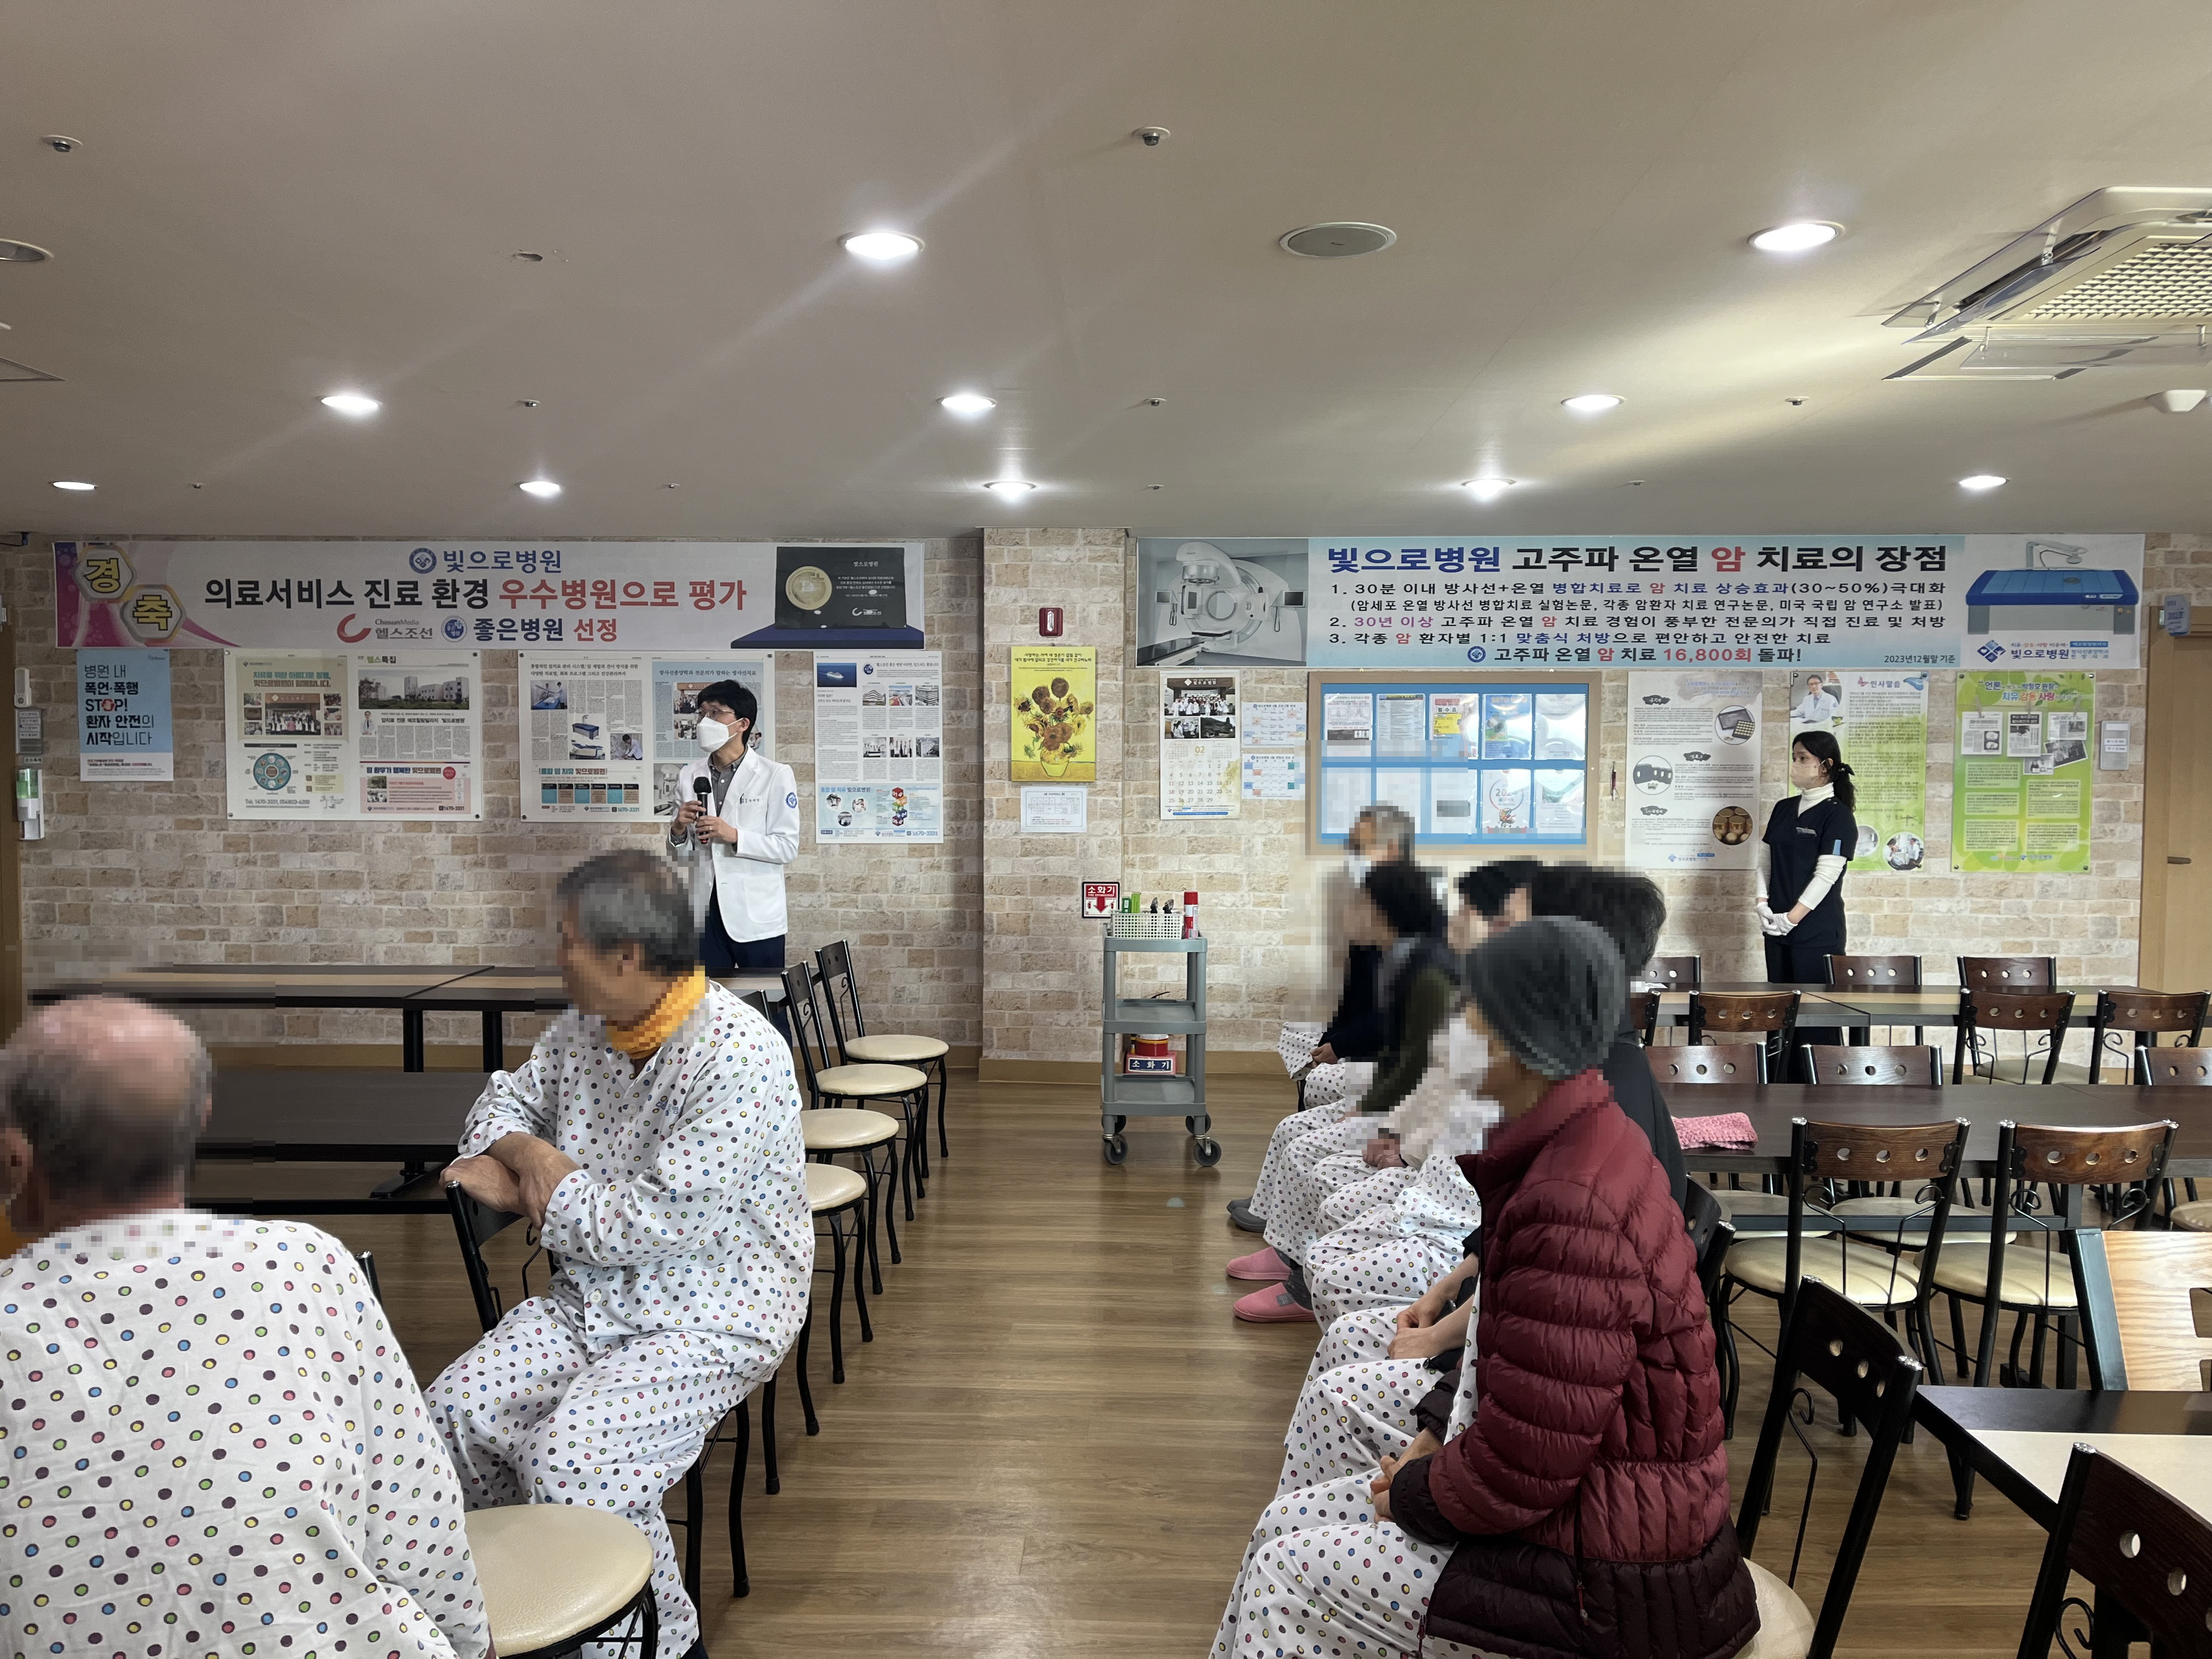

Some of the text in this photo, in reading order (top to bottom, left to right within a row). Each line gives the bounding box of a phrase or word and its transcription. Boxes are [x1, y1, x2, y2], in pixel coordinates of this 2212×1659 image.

[443, 549, 562, 573] 빛으로병원
[1328, 546, 1946, 573] 빛으로병원 고주파 온열 암 치료의 장점
[83, 558, 121, 594] 경
[204, 578, 747, 611] 의료서비스 진료 환경 우수병원으로 평가
[1331, 582, 1945, 595] 1. 30분 이내 방사선+온열 병합치료로 암 치료 상승효과(30~50%)극대화
[1350, 599, 1943, 612] (암세포 온열 방사선 병합치료 실험논문, 각종 암환자 치료 연구논문, 미국 국립 암 연구소 발표)
[132, 594, 171, 632] 축
[1329, 616, 1945, 628] 2. 30년 이상 고주파 온열 암 치료 경험이 풍부한 전문의가 직접 진료 및 처방
[375, 628, 433, 640] 헬스조선
[473, 618, 617, 642] 좋은병원 선정
[1329, 632, 1831, 645] 3. 각종 암 환자별 1:1 맞춤식 처방으로 편안하고 안전한 치료
[1494, 648, 1802, 663] 고주파 온열 암 치료 16,800회 돌파!
[1940, 654, 1956, 664] 기준
[2011, 649, 2070, 659] 빛으로병원
[84, 664, 126, 679] 병원 내
[84, 681, 139, 695] 폭언·폭행
[2002, 692, 2019, 701] 치유
[2020, 692, 2036, 701] 감동
[2039, 692, 2055, 701] 사랑
[86, 698, 128, 712] STOP!
[86, 714, 154, 729] 환자 안전의
[86, 732, 153, 746] 시작입니다
[1087, 885, 1115, 894] 소화기
